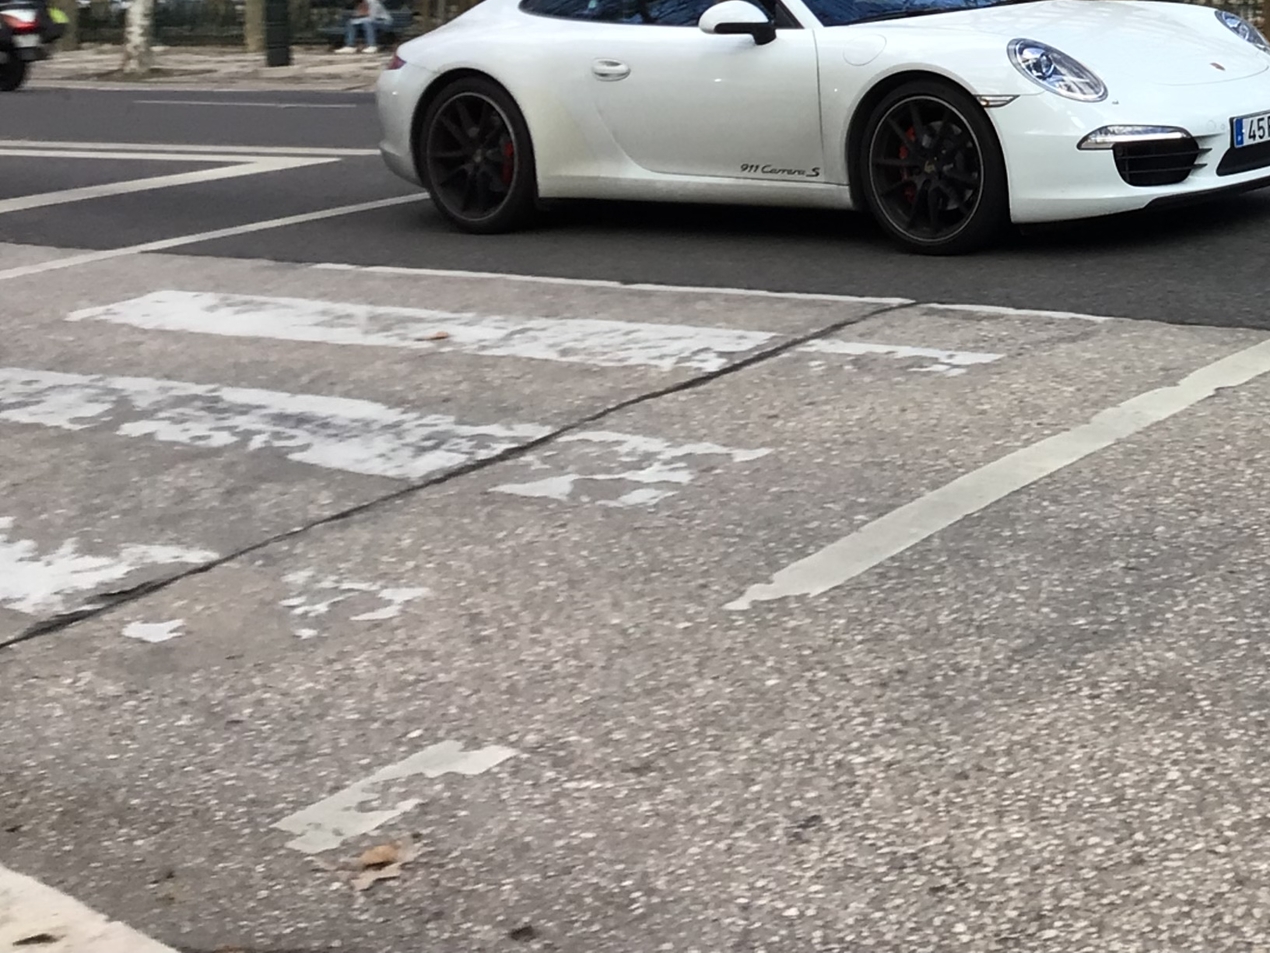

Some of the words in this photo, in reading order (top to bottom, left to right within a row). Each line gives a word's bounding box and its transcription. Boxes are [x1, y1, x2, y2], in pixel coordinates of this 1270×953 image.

[740, 163, 760, 173] 911
[761, 164, 806, 176] Carrera
[806, 167, 821, 178] S
